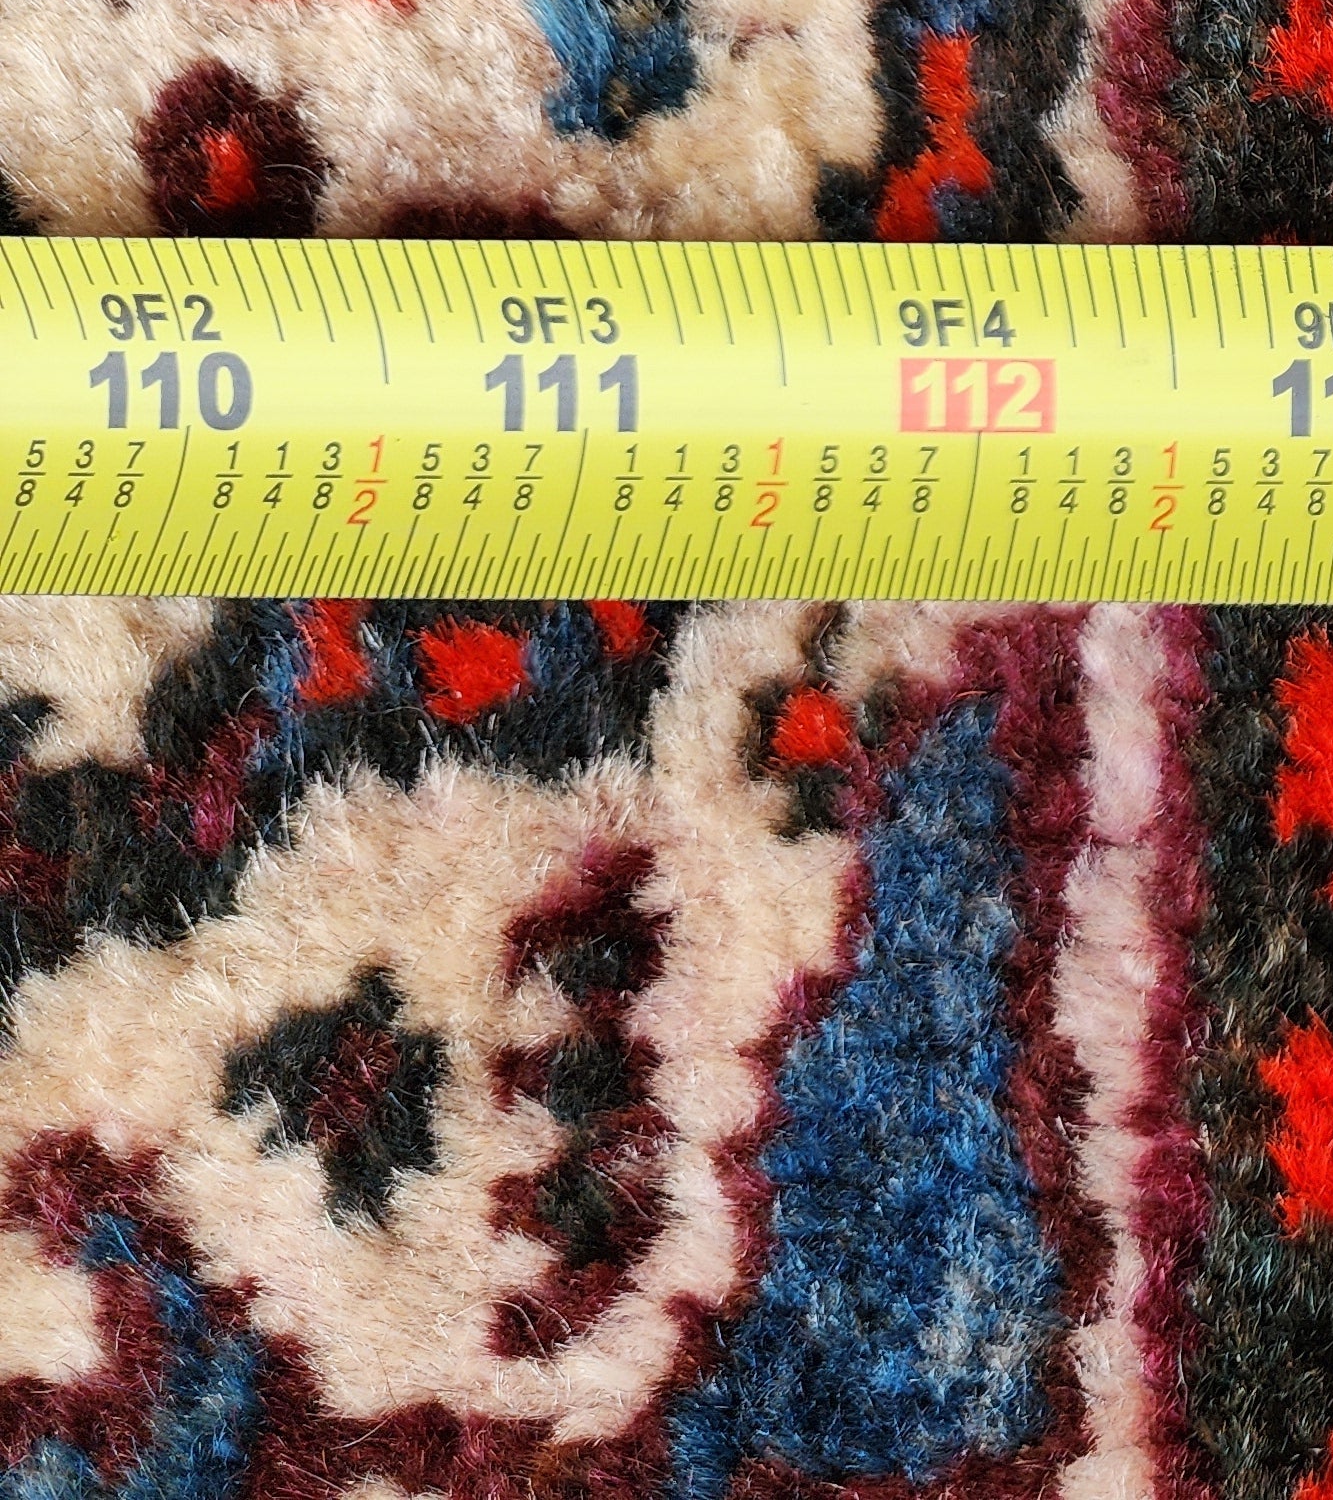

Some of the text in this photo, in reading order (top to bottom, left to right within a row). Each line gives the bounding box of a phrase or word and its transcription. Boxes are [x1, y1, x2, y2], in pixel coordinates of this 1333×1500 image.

[101, 294, 221, 340] 9F 2
[502, 297, 617, 344] 9F 3
[899, 300, 1016, 347] 9F 4
[90, 352, 251, 430] 110
[486, 355, 636, 432] 111
[911, 359, 1043, 429] 112
